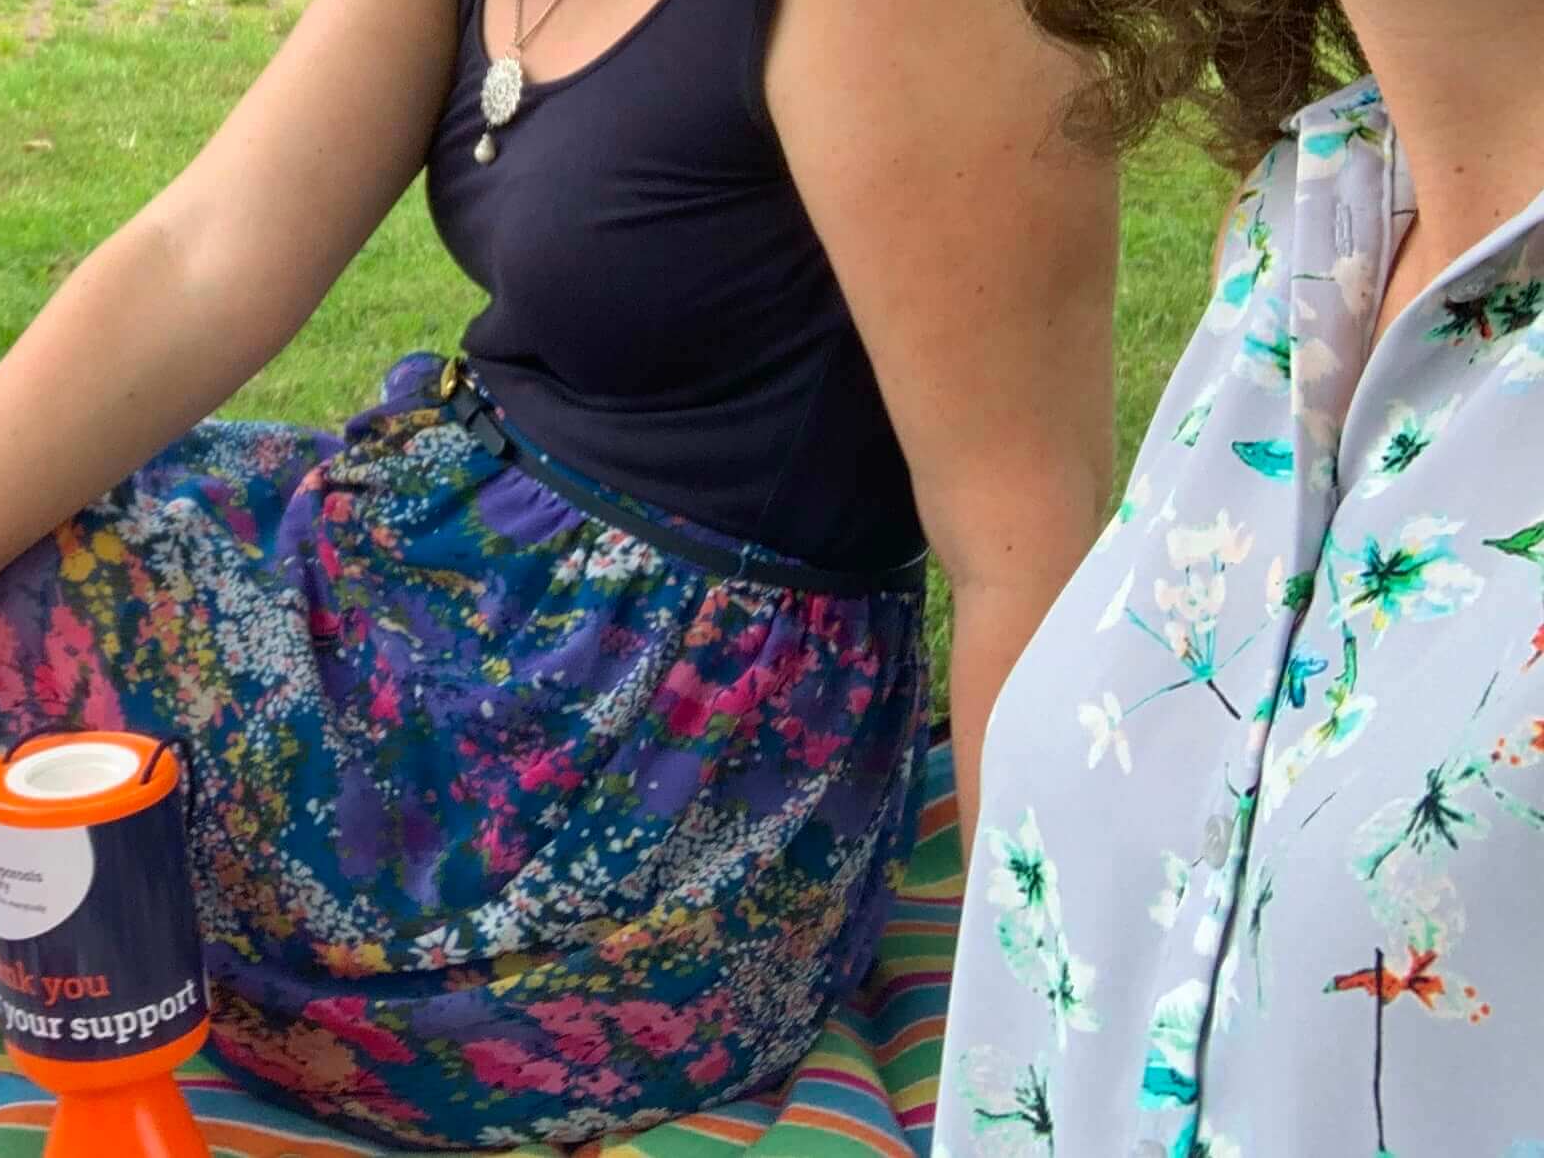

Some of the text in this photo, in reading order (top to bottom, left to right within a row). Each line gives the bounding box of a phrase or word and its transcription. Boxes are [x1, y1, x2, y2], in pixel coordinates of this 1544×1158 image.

[3, 1000, 64, 1039] your
[69, 979, 197, 1044] support
[41, 974, 110, 1006] you
